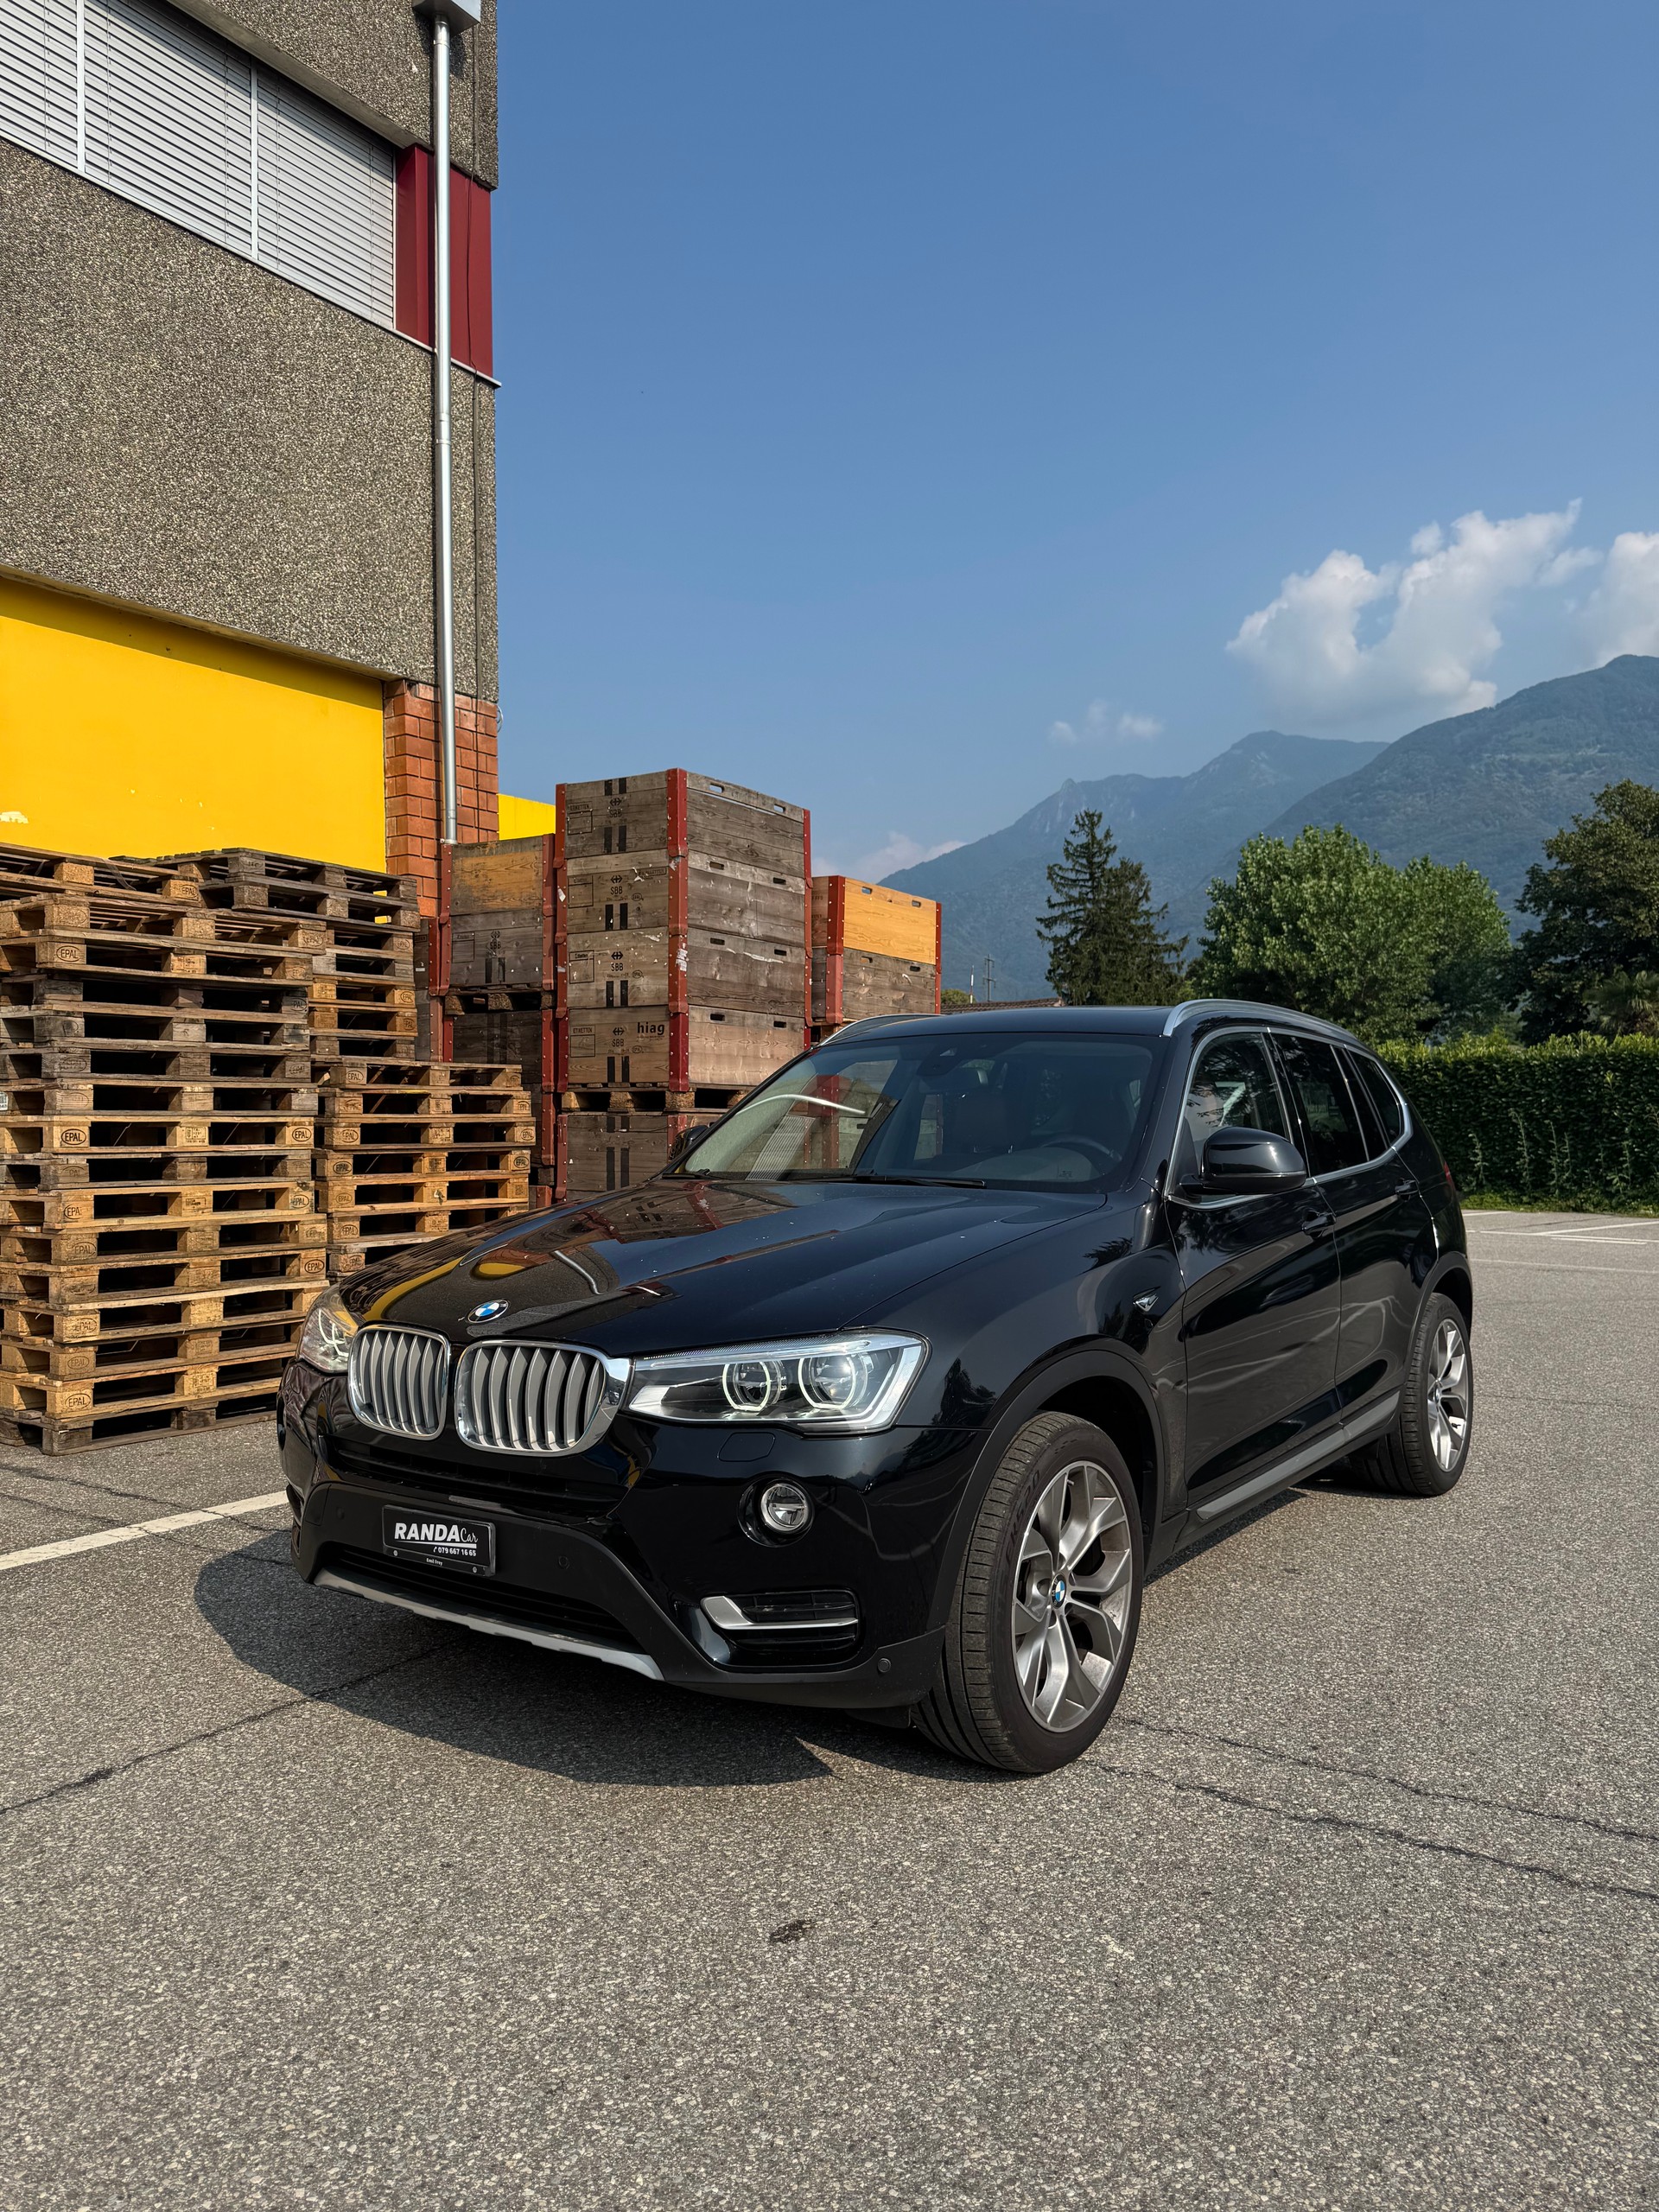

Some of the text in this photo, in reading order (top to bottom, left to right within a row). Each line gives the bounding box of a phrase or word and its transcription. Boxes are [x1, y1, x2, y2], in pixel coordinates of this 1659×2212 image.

[181, 886, 196, 896] EPAL
[610, 886, 623, 895] SBB
[60, 949, 79, 959] EPAL
[611, 963, 624, 971] SBB
[638, 1022, 665, 1035] hiag
[612, 1039, 625, 1047] SBB
[65, 1133, 83, 1142] EPAL
[295, 1130, 308, 1139] EPAL
[74, 1245, 92, 1255] EPAL
[308, 1262, 322, 1271] EPAL
[71, 1358, 86, 1367] EPAL
[68, 1396, 87, 1408] EPAL
[394, 1522, 479, 1543] RANDA Car
